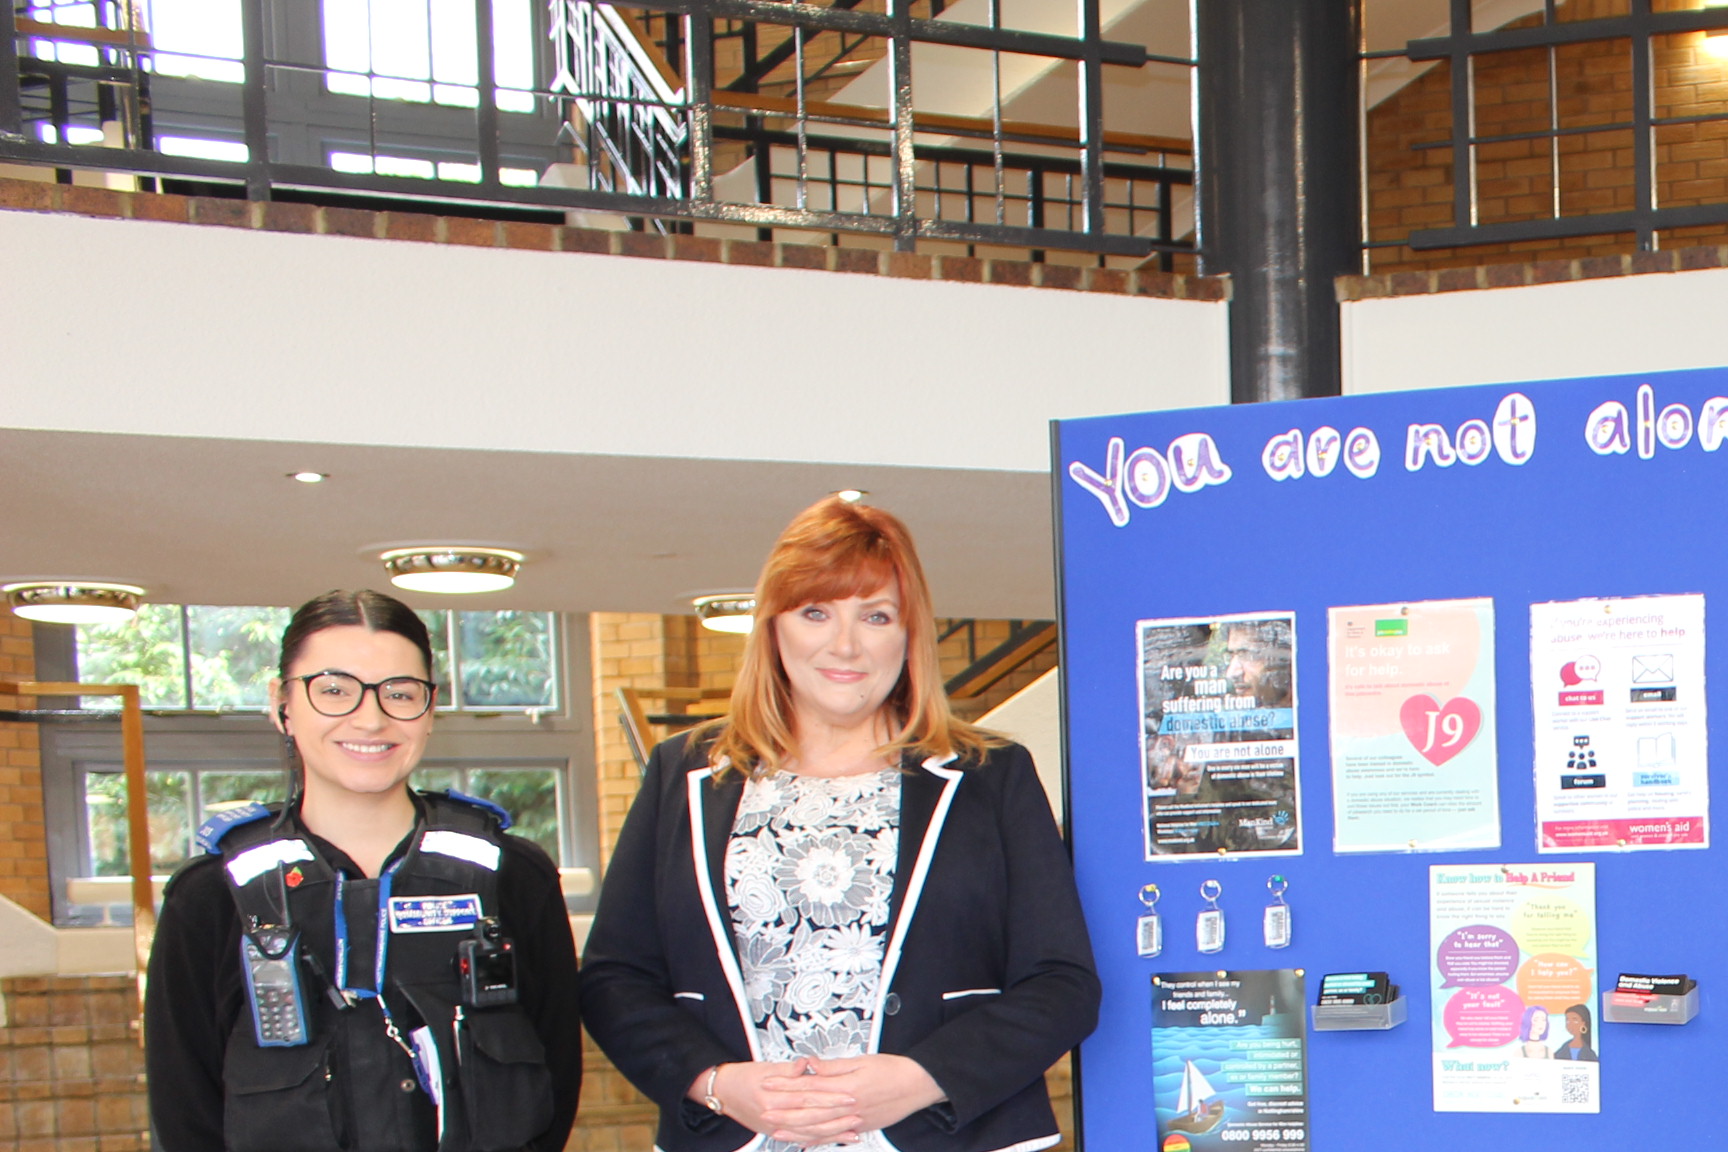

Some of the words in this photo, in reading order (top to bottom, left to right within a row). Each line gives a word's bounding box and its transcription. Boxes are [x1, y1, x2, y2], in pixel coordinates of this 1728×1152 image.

[1070, 432, 1231, 527] You
[1262, 425, 1381, 482] are
[1405, 392, 1536, 472] not
[1596, 614, 1664, 628] experiencing
[1619, 628, 1643, 640] here
[1646, 628, 1657, 639] to
[1660, 627, 1686, 639] help
[1345, 645, 1365, 658] It's
[1370, 643, 1403, 659] okay
[1407, 643, 1421, 656] to
[1424, 641, 1450, 655] ask
[1160, 665, 1182, 680] Are
[1185, 666, 1207, 682] you
[1209, 667, 1217, 678] a
[1345, 664, 1365, 676] for
[1194, 679, 1227, 695] man
[1162, 696, 1221, 713] suffering
[1224, 694, 1256, 709] from
[1166, 714, 1225, 732] domestic
[1229, 711, 1275, 728] abuse?
[1421, 710, 1464, 752] J9
[1191, 746, 1210, 759] You
[1213, 748, 1230, 758] are
[1233, 746, 1251, 757] not
[1255, 745, 1284, 756] alone
[1629, 822, 1672, 834] women's
[1674, 821, 1690, 832] aid
[1436, 873, 1467, 884] Know
[1469, 873, 1492, 883] how
[1494, 874, 1503, 883] to
[1505, 872, 1528, 885] Help
[1531, 872, 1538, 883] A
[1541, 872, 1575, 882] Friend
[1477, 933, 1496, 941] sorry
[1161, 981, 1175, 989] They
[1176, 980, 1196, 988] control
[1197, 980, 1214, 988] when
[1167, 1000, 1185, 1010] feel
[1186, 999, 1237, 1012] completely
[1441, 1060, 1474, 1071] What
[1477, 1060, 1510, 1071] now?
[1249, 1085, 1263, 1093] We
[1264, 1085, 1278, 1093] can
[1221, 1129, 1249, 1141] 0800
[1252, 1129, 1280, 1141] 9956
[1282, 1129, 1304, 1140] 999
